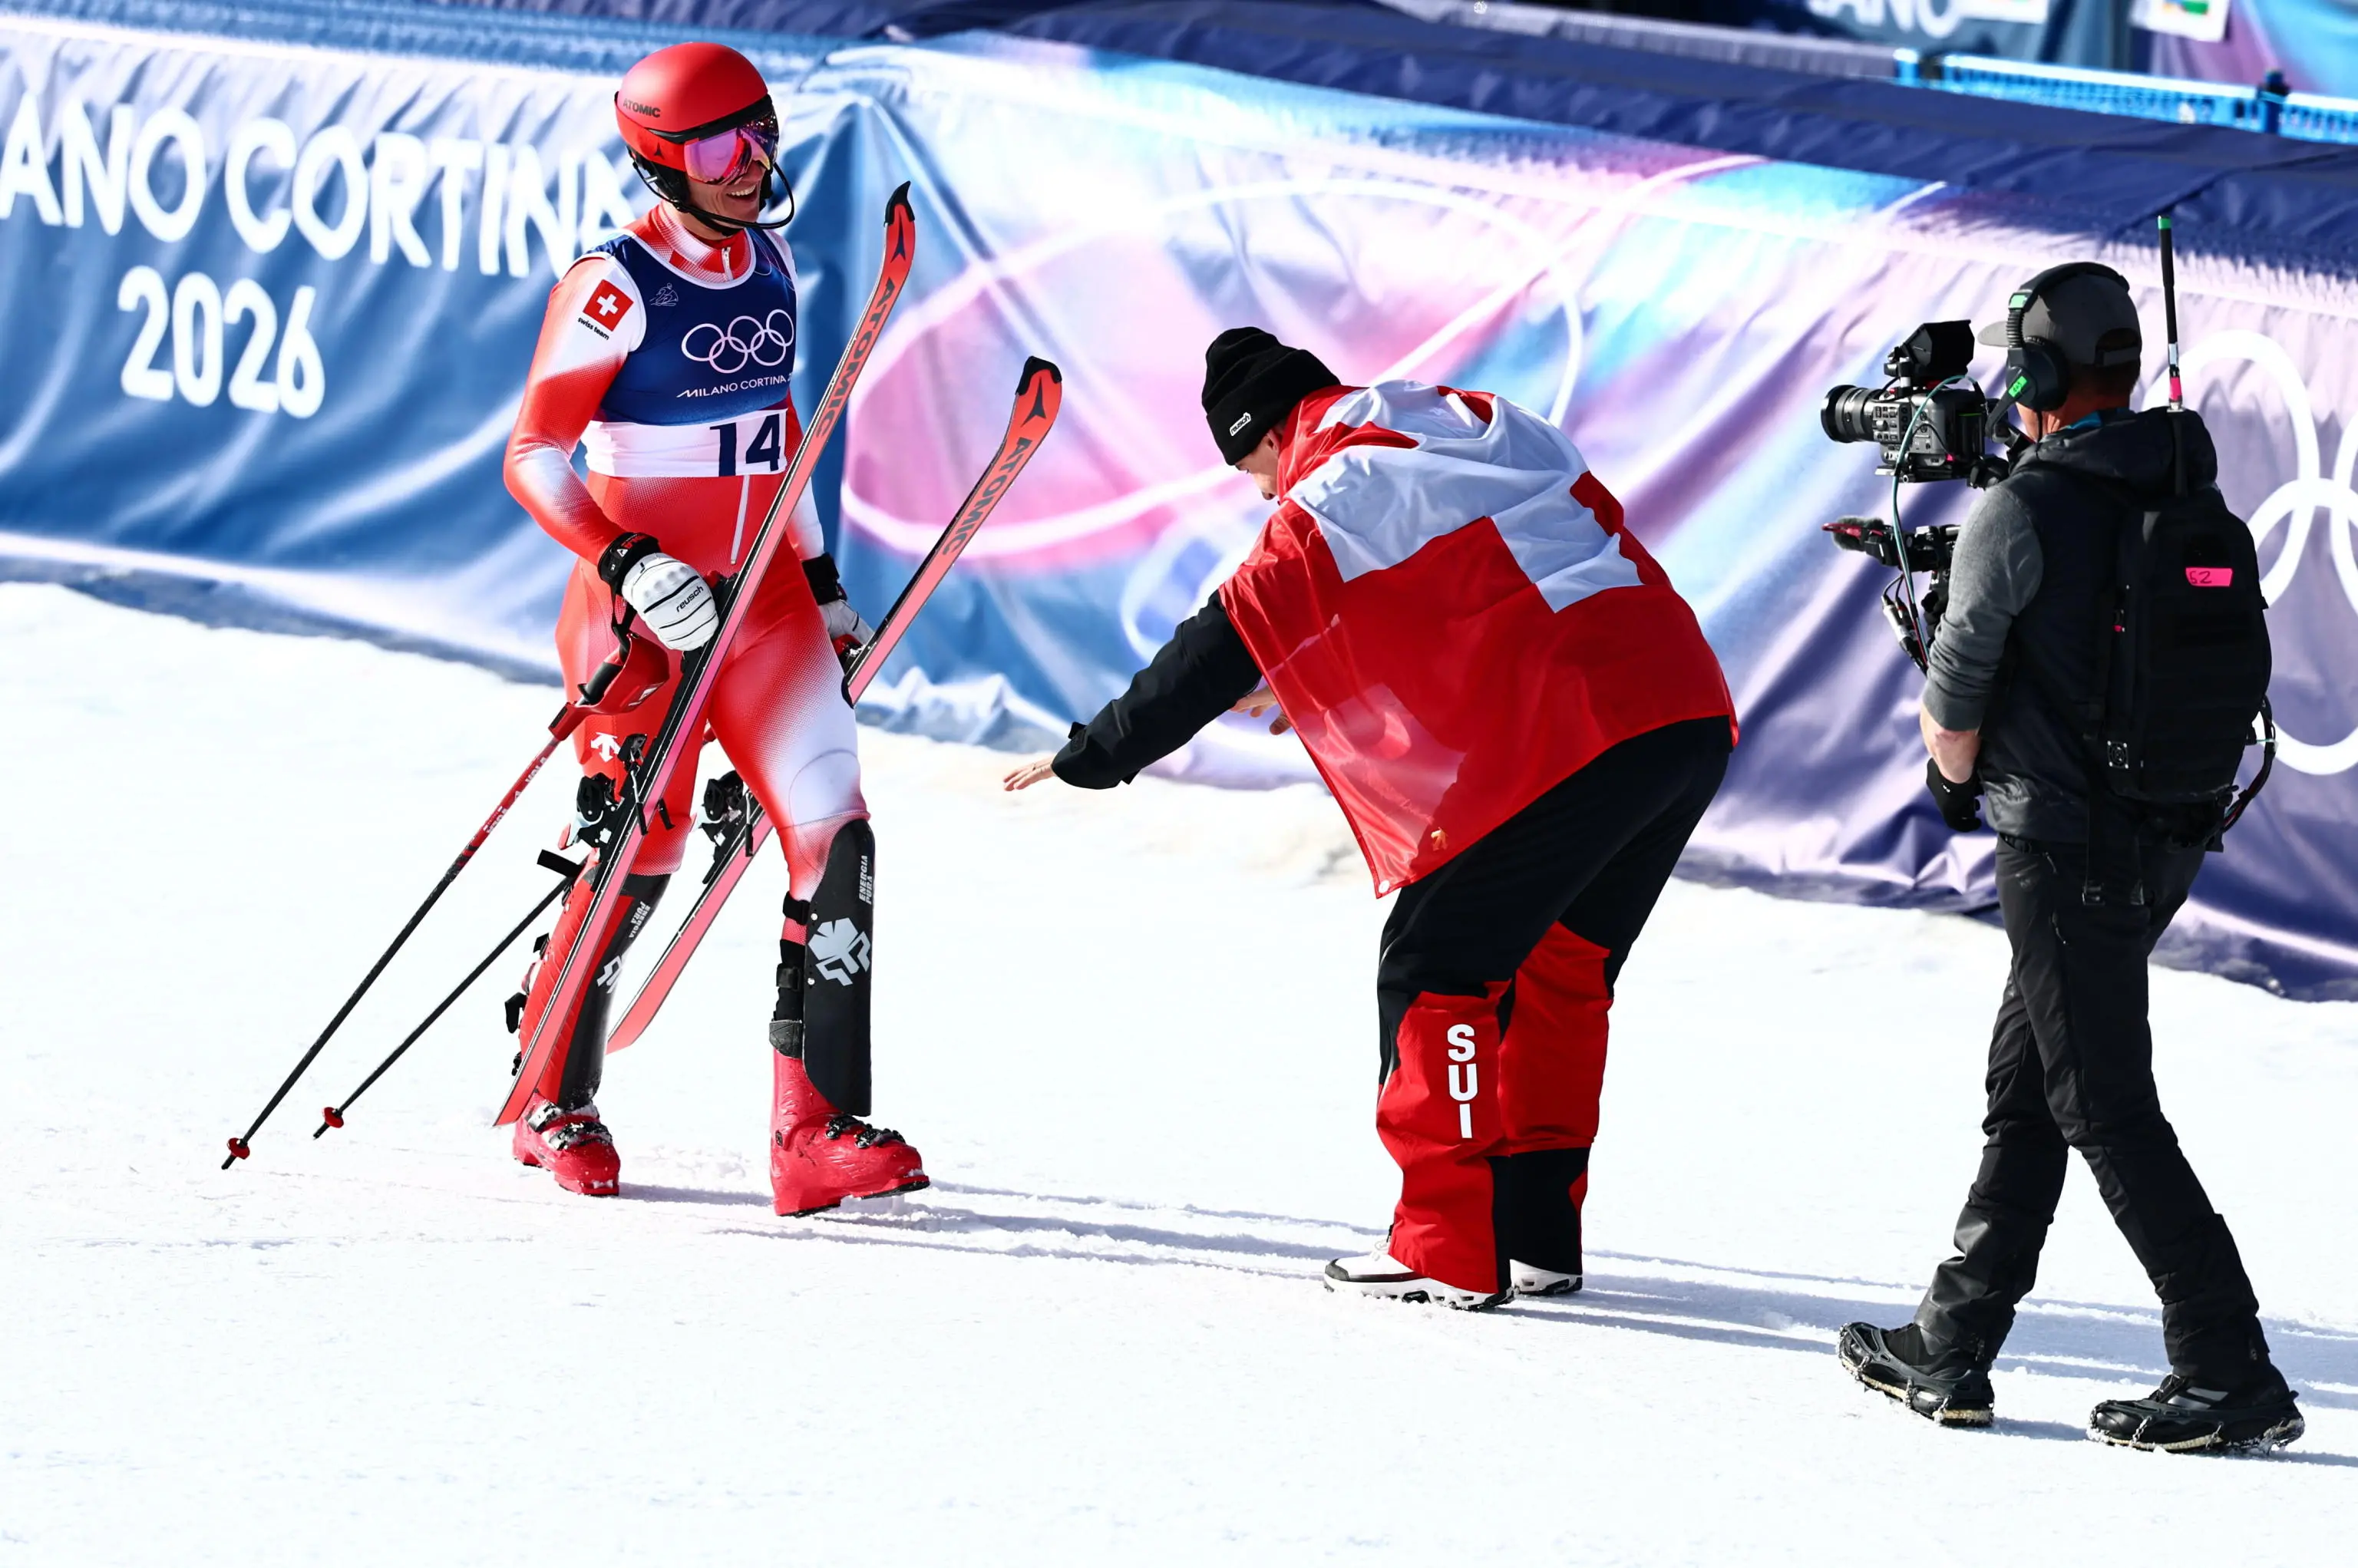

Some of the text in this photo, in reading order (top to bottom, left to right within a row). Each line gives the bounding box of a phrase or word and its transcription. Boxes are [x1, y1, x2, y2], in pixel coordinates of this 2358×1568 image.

[623, 98, 661, 117] ATOMIC
[225, 118, 636, 279] CORTINA
[117, 266, 325, 418] 2026
[577, 317, 609, 341] swiss team
[815, 277, 895, 438] ATOMIC
[676, 382, 738, 398] MILANO
[740, 375, 787, 390] CORTINA
[709, 413, 781, 477] 14
[943, 437, 1032, 555] ATOMIC
[676, 586, 704, 612] reusch
[859, 855, 868, 902] ENERGIA
[1447, 1024, 1478, 1138] SUI
